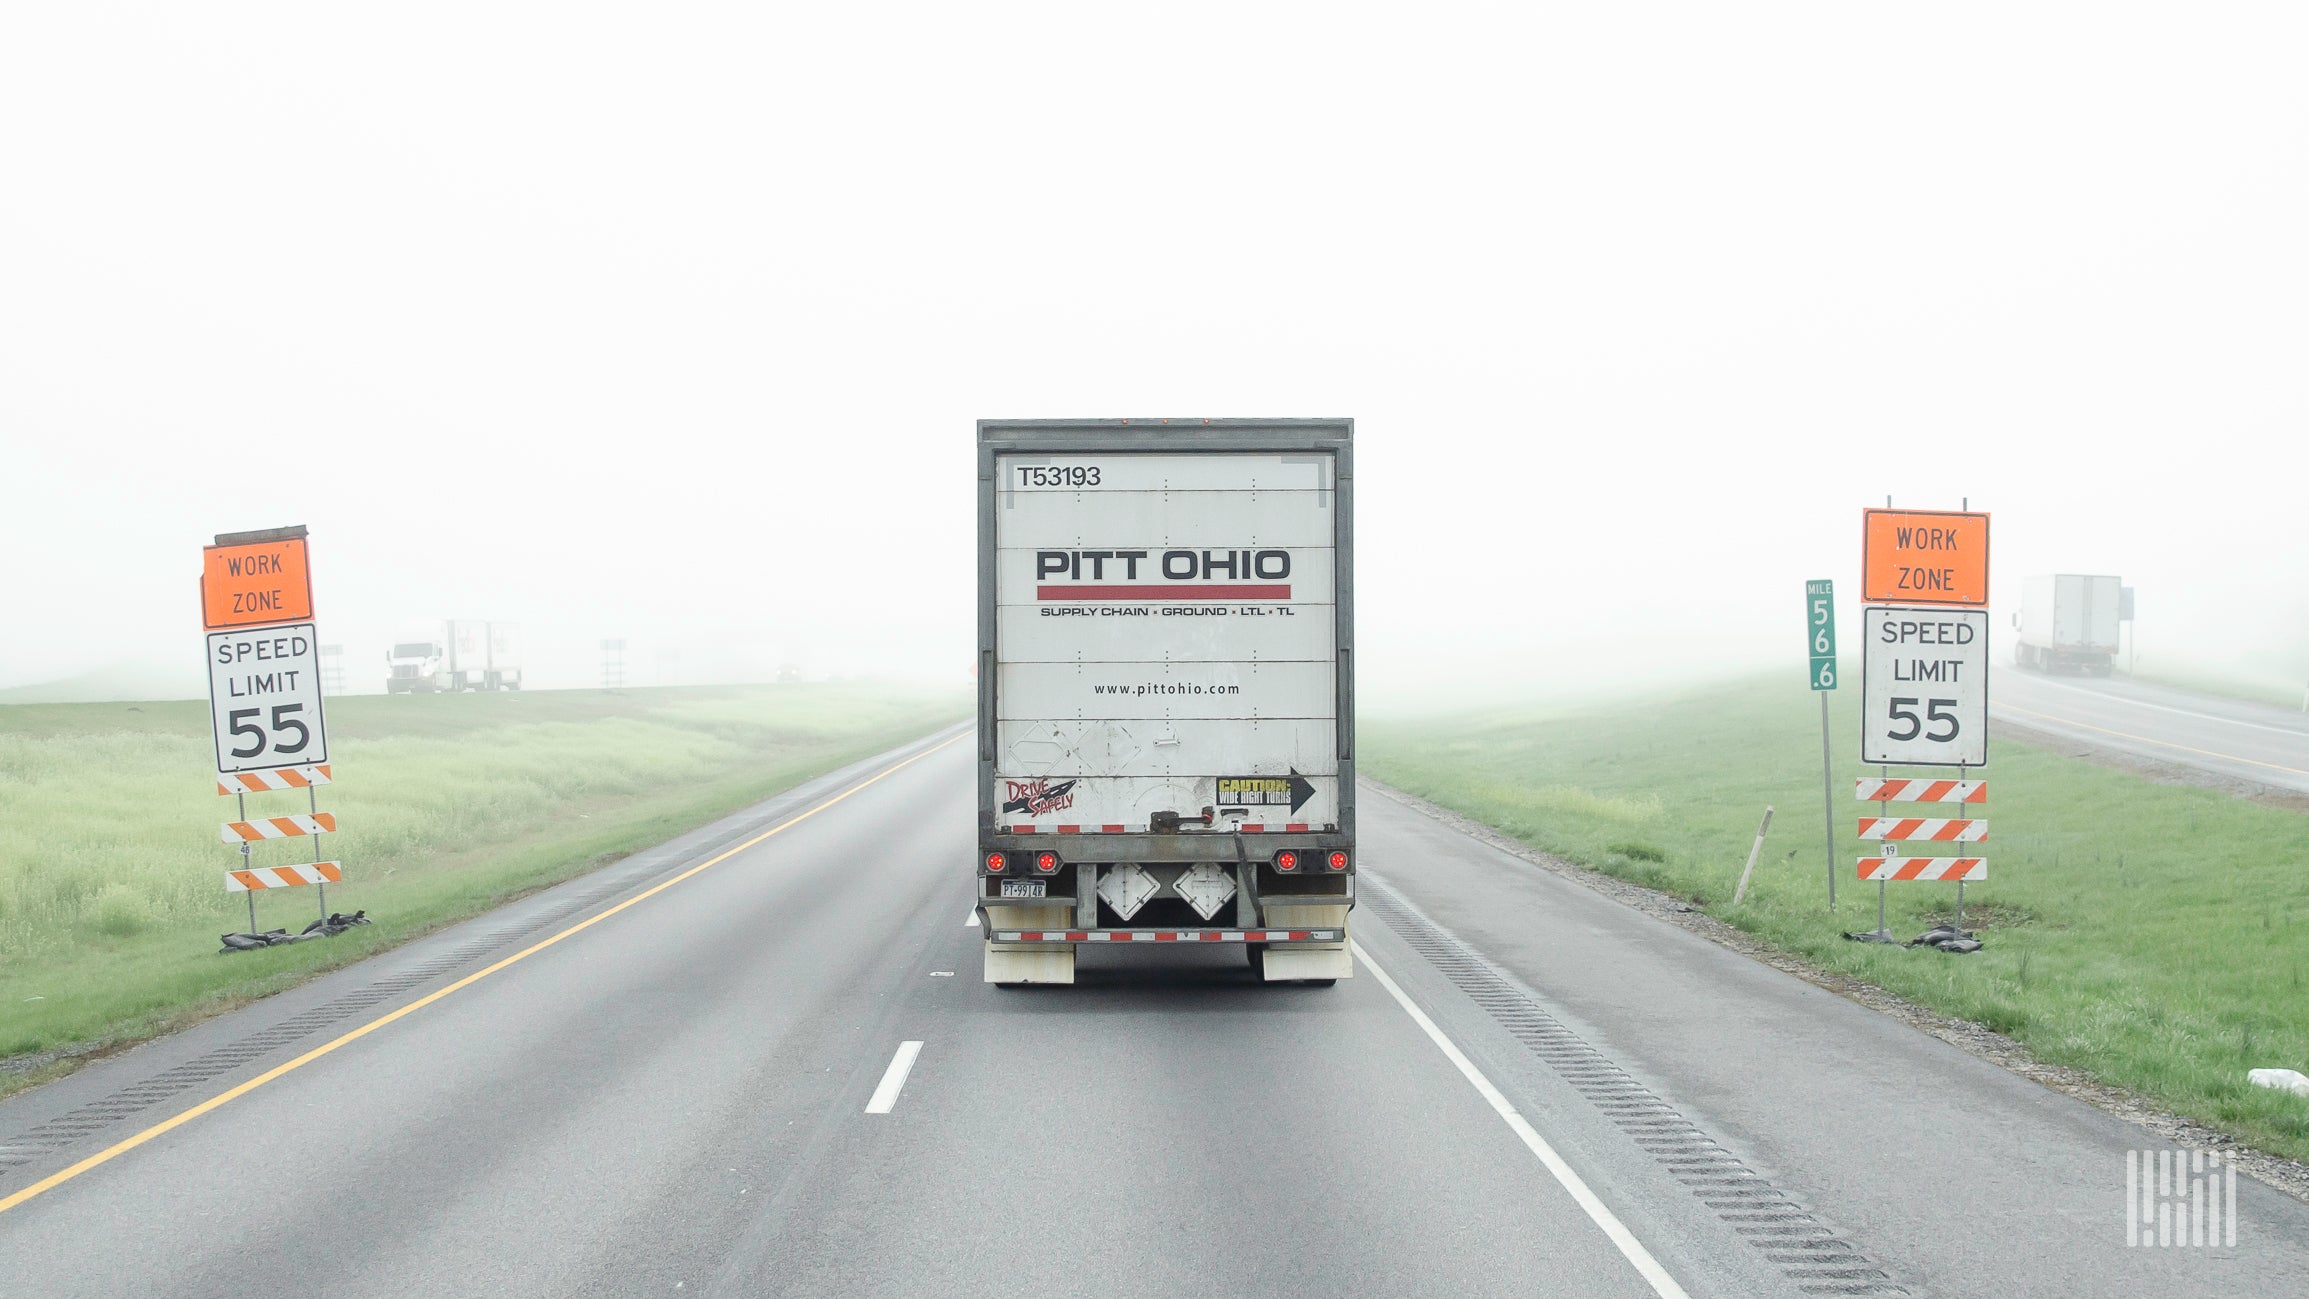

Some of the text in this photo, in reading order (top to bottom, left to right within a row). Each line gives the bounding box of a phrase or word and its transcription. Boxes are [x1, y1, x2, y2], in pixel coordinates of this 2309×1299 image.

[1017, 466, 1101, 487] T53193
[1896, 527, 1958, 551] WORK
[228, 553, 283, 577] WORK
[1036, 550, 1292, 581] PITT OHIO
[1808, 583, 1832, 594] MILE
[1897, 567, 1955, 591] ZONE
[233, 590, 284, 614] ZONE
[1041, 607, 1295, 617] SUPPLY CHAIN GROUND LTL TL
[1881, 621, 1975, 645] SPEED
[218, 637, 308, 664] SPEED
[1894, 658, 1964, 683] LIMIT
[230, 671, 299, 698] LIMIT
[1094, 682, 1240, 697] www.pittohio.com
[229, 703, 310, 758] 55
[1887, 697, 1960, 742] 55
[1005, 776, 1050, 802] DRIVE
[1219, 792, 1291, 804] WIDE RIGHT TURNS
[1029, 792, 1074, 818] SAFELY
